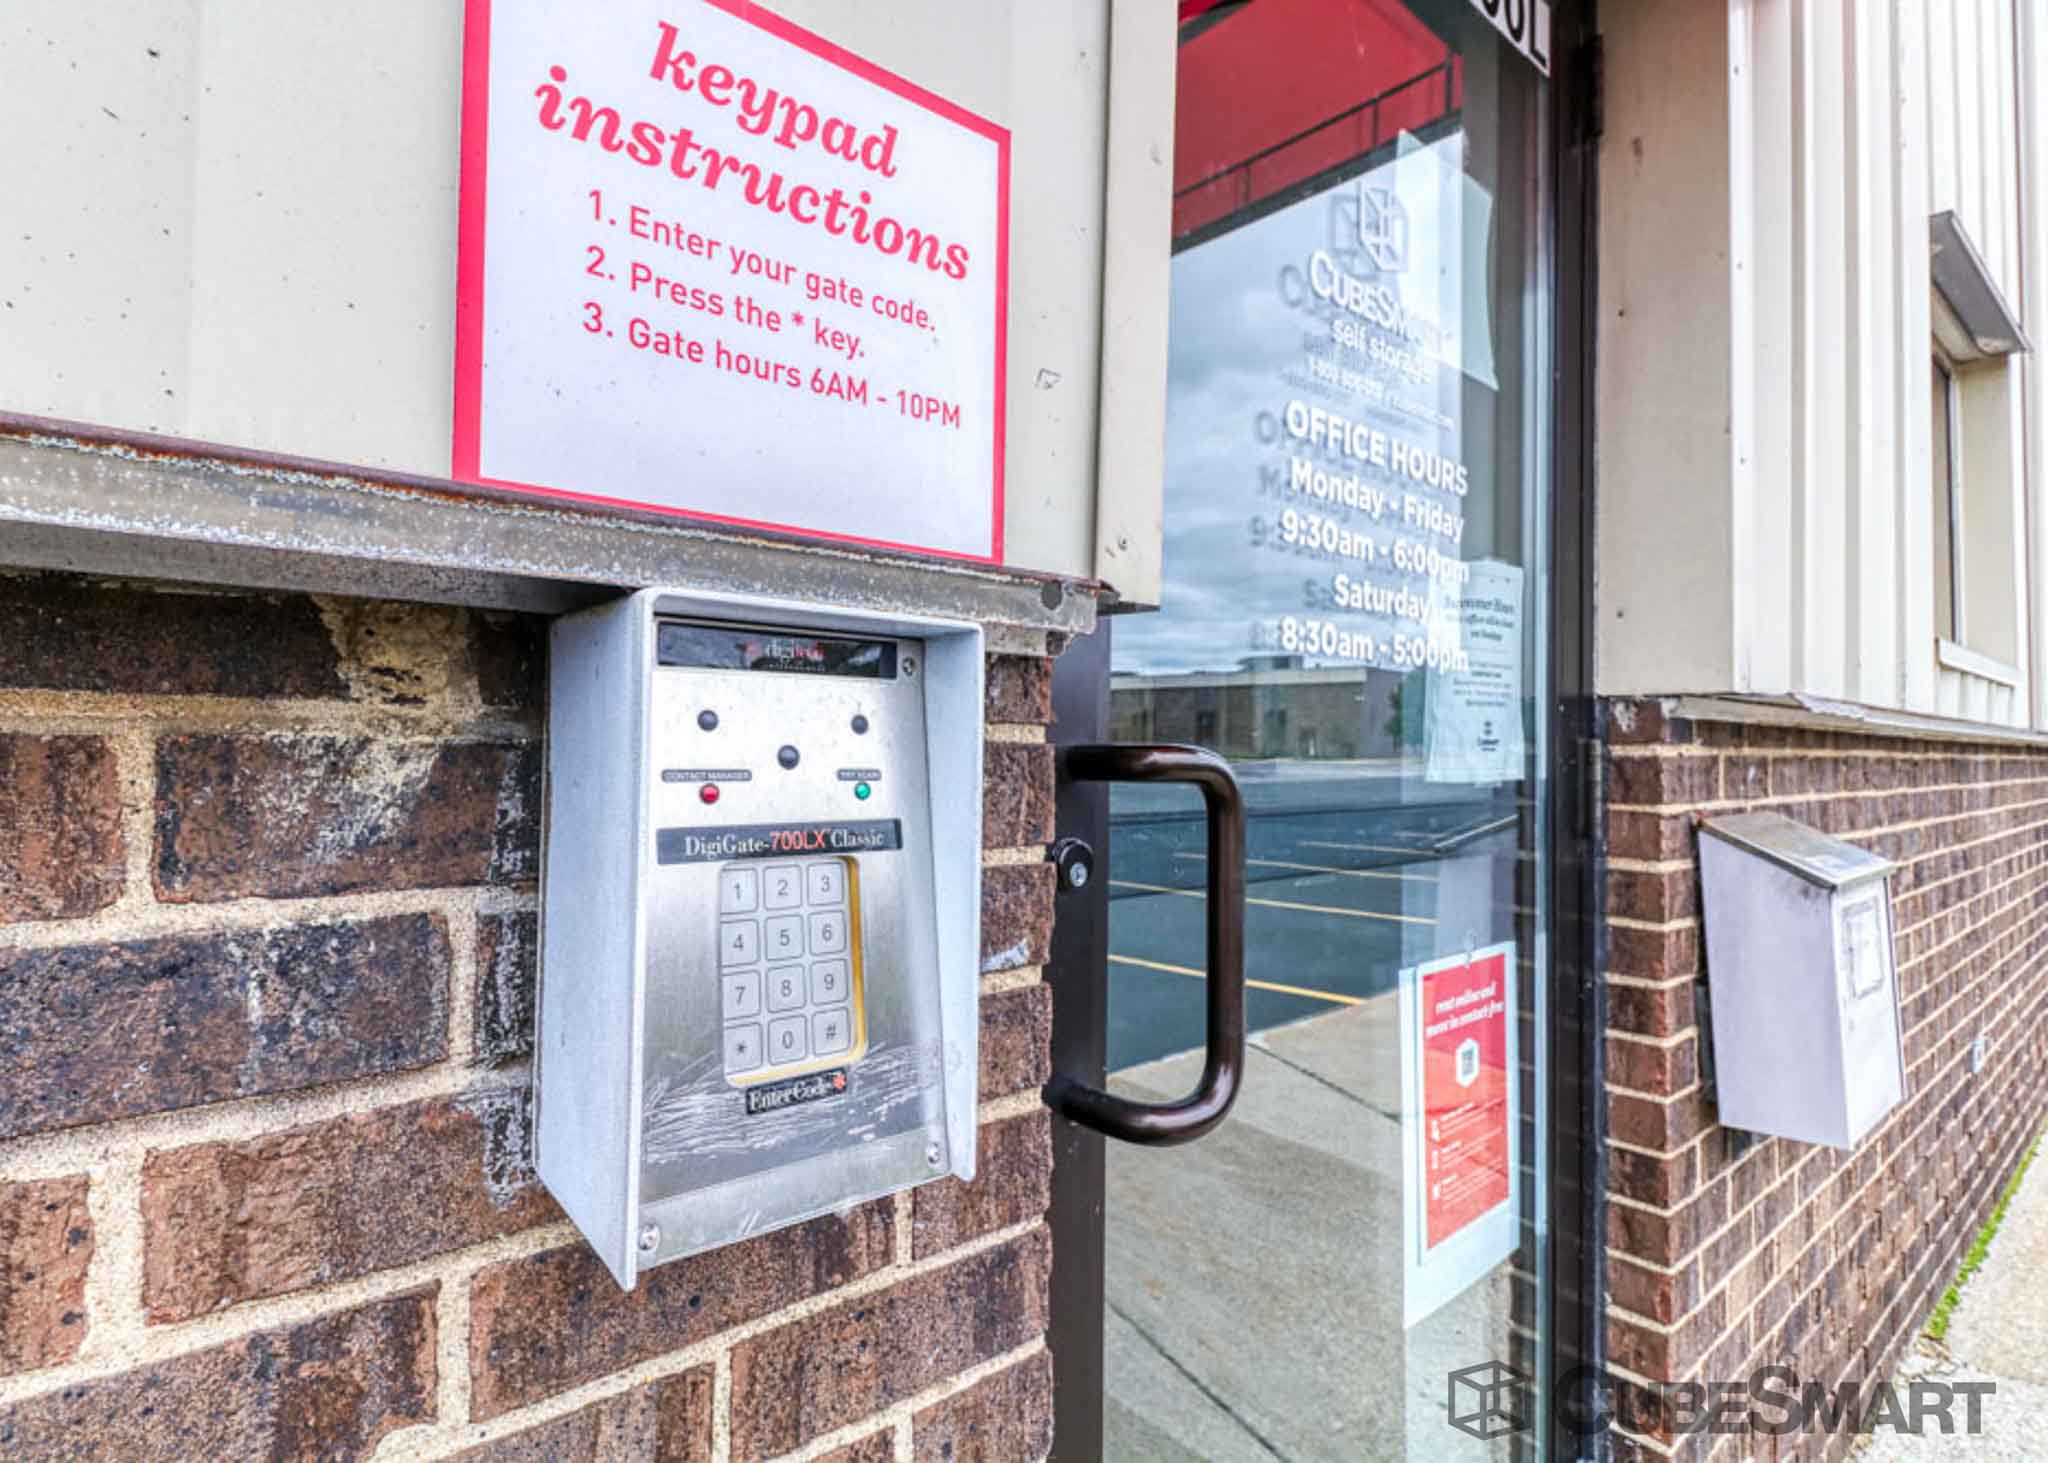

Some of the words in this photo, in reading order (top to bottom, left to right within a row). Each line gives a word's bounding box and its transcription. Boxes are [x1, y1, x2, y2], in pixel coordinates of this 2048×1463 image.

[649, 20, 898, 177] keypad
[535, 65, 970, 280] instructions
[589, 190, 616, 225] 1.
[629, 206, 720, 260] Enter
[728, 246, 797, 286] your
[806, 271, 863, 309] gate
[872, 294, 936, 331] code.
[585, 246, 615, 280] 2.
[631, 262, 724, 315] Press
[734, 295, 781, 332] the
[816, 318, 864, 360] key.
[583, 302, 613, 337] 3.
[628, 319, 703, 362] Gate
[716, 341, 800, 388] hours
[810, 367, 868, 404] 6AM
[897, 390, 961, 429] 10PM
[1286, 400, 1386, 465] OFFICE
[1391, 440, 1469, 497] HOURS
[1289, 457, 1384, 520] Monday
[1403, 495, 1465, 544] Friday
[1281, 508, 1375, 561] 9:30am
[1393, 540, 1470, 587] 6:00pm
[1334, 574, 1434, 626] Saturday
[1280, 615, 1374, 661] 8:30am
[1393, 634, 1470, 676] 5:00pm
[830, 829, 885, 848] Classic
[733, 883, 742, 900] 1
[777, 879, 789, 897] 2
[820, 875, 831, 892] 3
[732, 934, 744, 951] 4
[779, 929, 791, 946] 5
[822, 924, 833, 941] 6
[736, 986, 746, 1004] 7
[780, 980, 792, 997] 8
[824, 974, 835, 991] 9
[782, 1031, 794, 1049] 0
[826, 1024, 837, 1041] #
